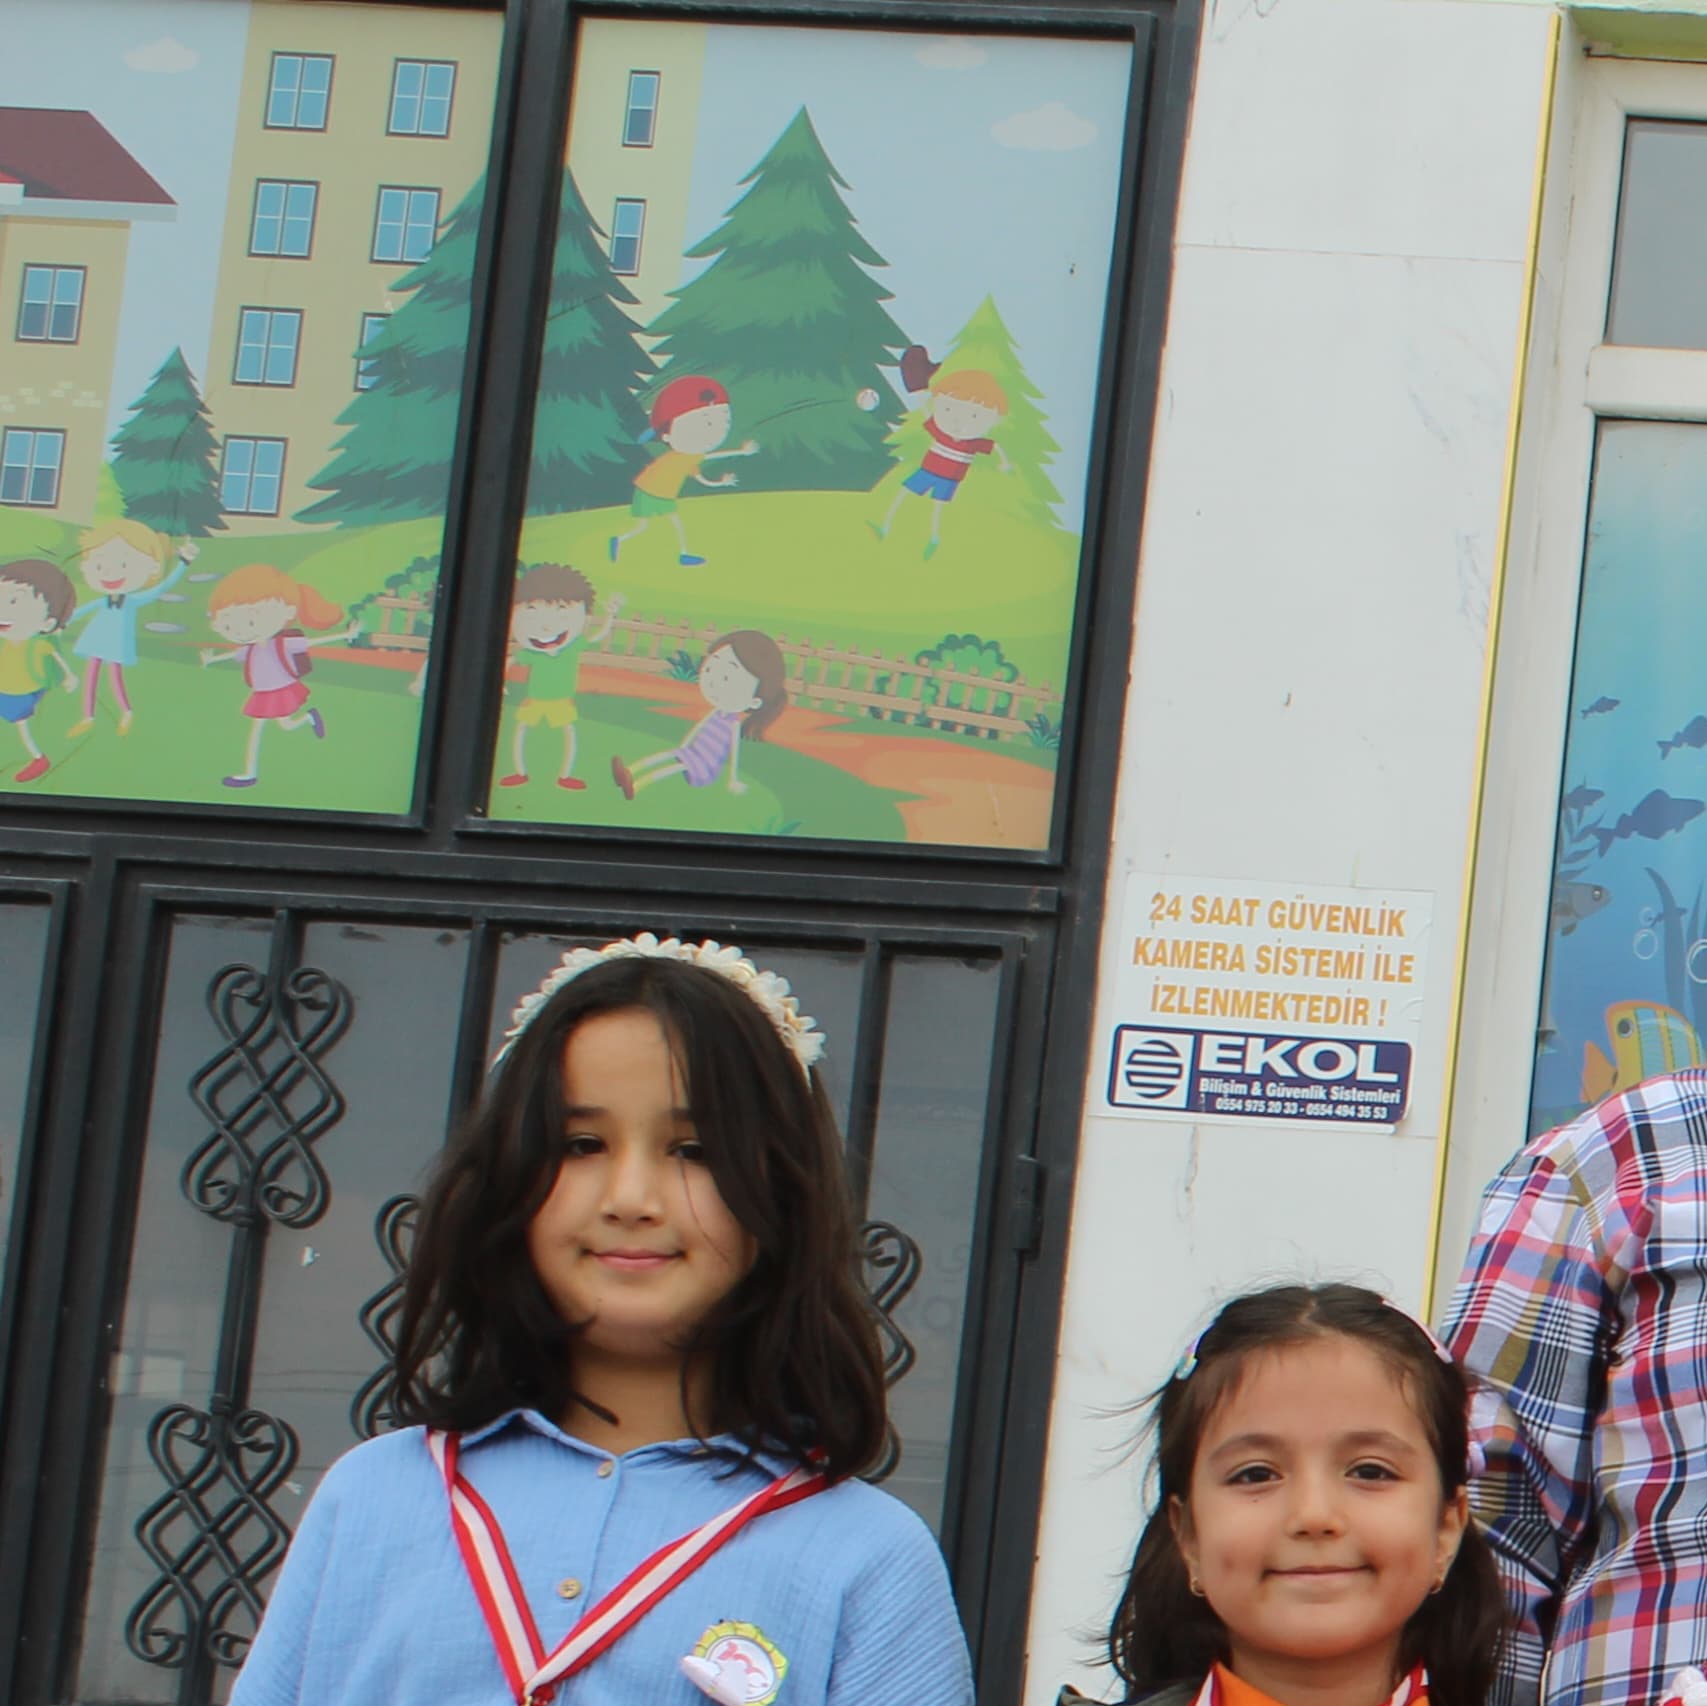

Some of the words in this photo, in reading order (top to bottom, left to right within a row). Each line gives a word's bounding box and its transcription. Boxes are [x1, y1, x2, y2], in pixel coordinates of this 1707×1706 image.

[1150, 892, 1182, 922] 24
[1190, 895, 1261, 928] SAAT
[1267, 894, 1407, 938] GÜVENLİK
[1132, 937, 1246, 973] KAMERA
[1255, 938, 1365, 981] SİSTEMİ
[1372, 945, 1415, 984] İLE
[1150, 975, 1370, 1027] İZLENMEKTEDİR
[1199, 1034, 1399, 1084] EKOL
[1199, 1077, 1248, 1098] Bilişim
[1250, 1080, 1263, 1097] &
[1266, 1082, 1328, 1101] Güvenlik
[1329, 1085, 1401, 1105] Sistemleri
